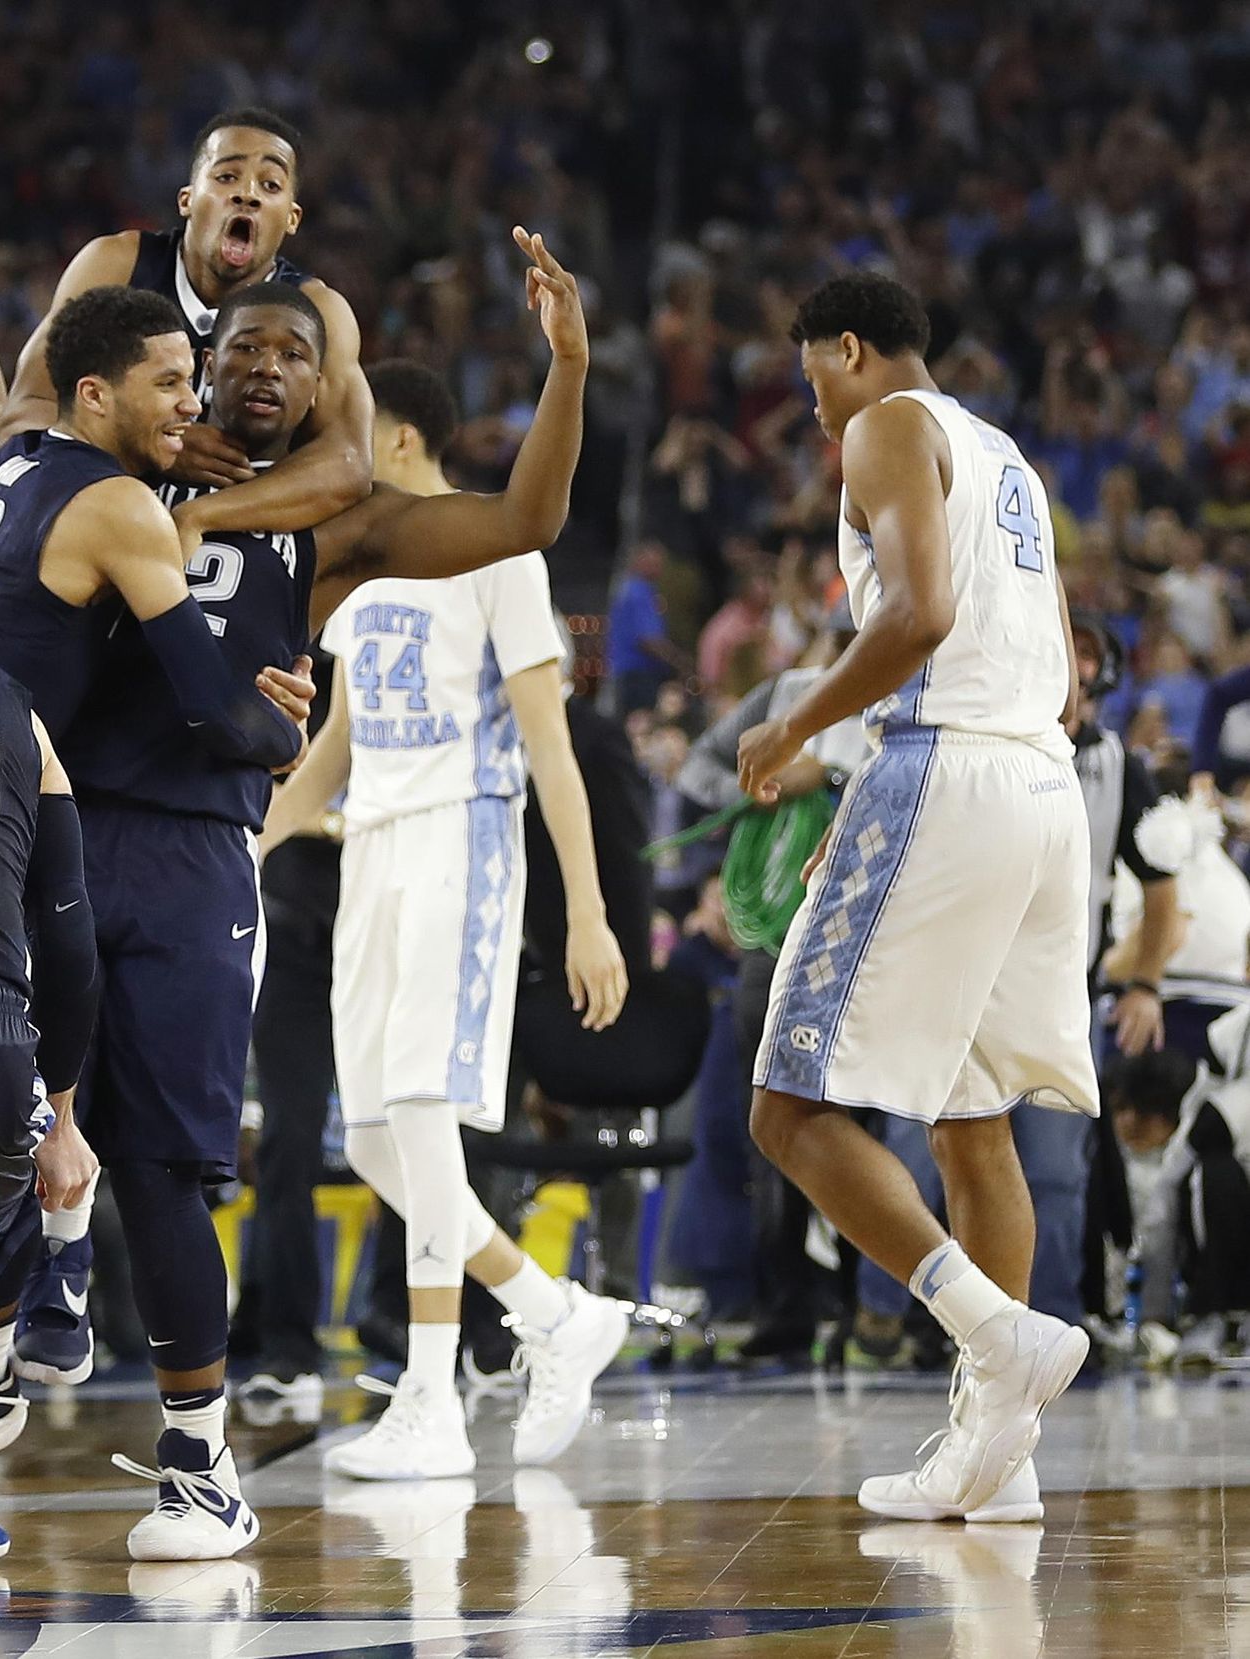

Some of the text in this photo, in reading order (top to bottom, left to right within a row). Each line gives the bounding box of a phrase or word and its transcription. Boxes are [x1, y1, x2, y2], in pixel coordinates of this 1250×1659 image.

[996, 465, 1043, 574] 4
[185, 541, 244, 637] 2
[353, 603, 432, 643] NORTH
[353, 640, 428, 711] 44
